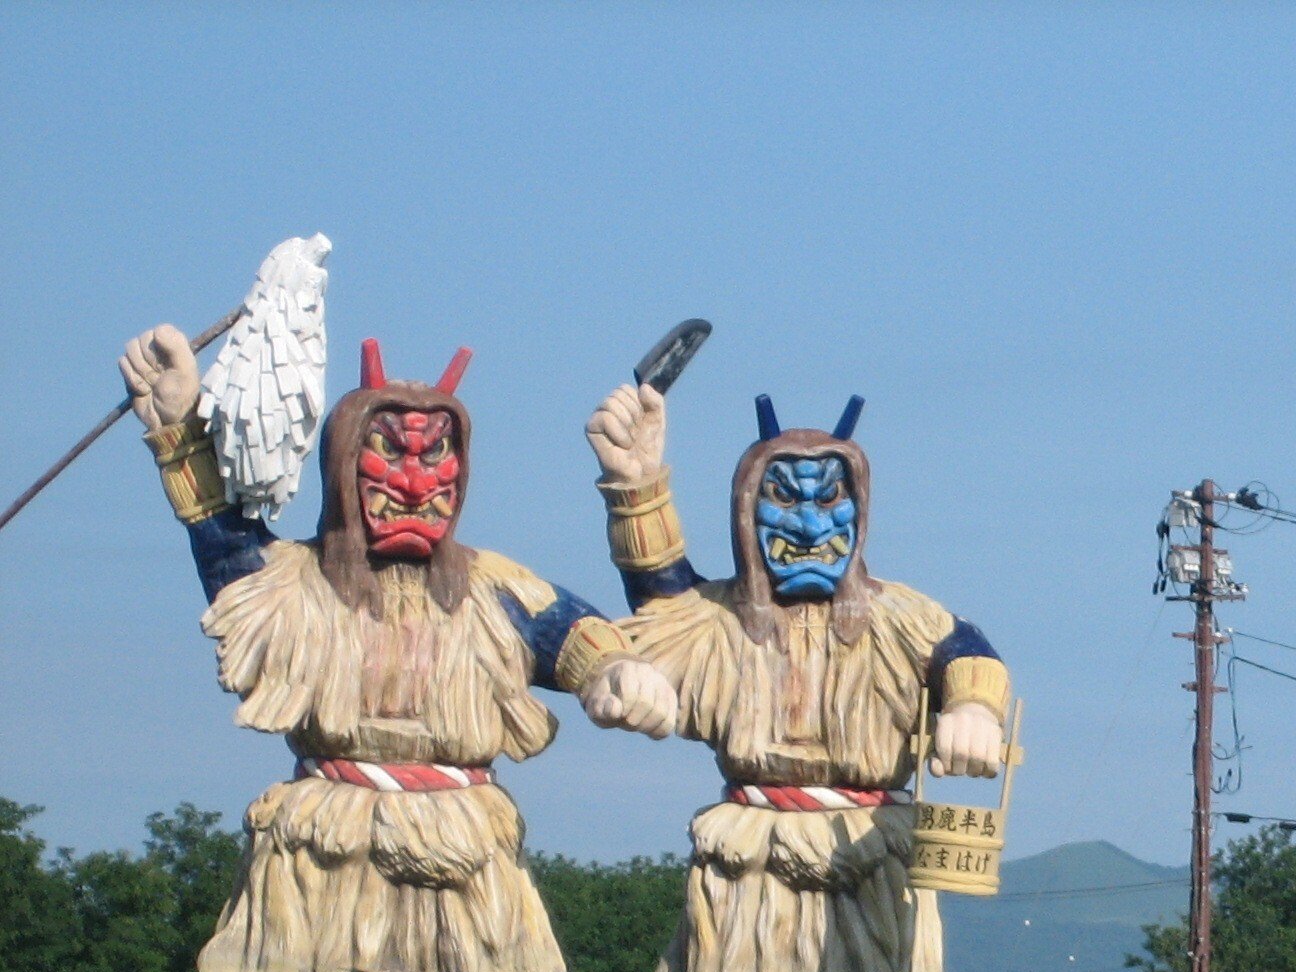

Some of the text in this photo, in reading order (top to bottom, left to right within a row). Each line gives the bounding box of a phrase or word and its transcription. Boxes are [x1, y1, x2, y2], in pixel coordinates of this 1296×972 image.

[921, 805, 996, 837] 男鹿半島
[917, 846, 992, 875] なまはげ
